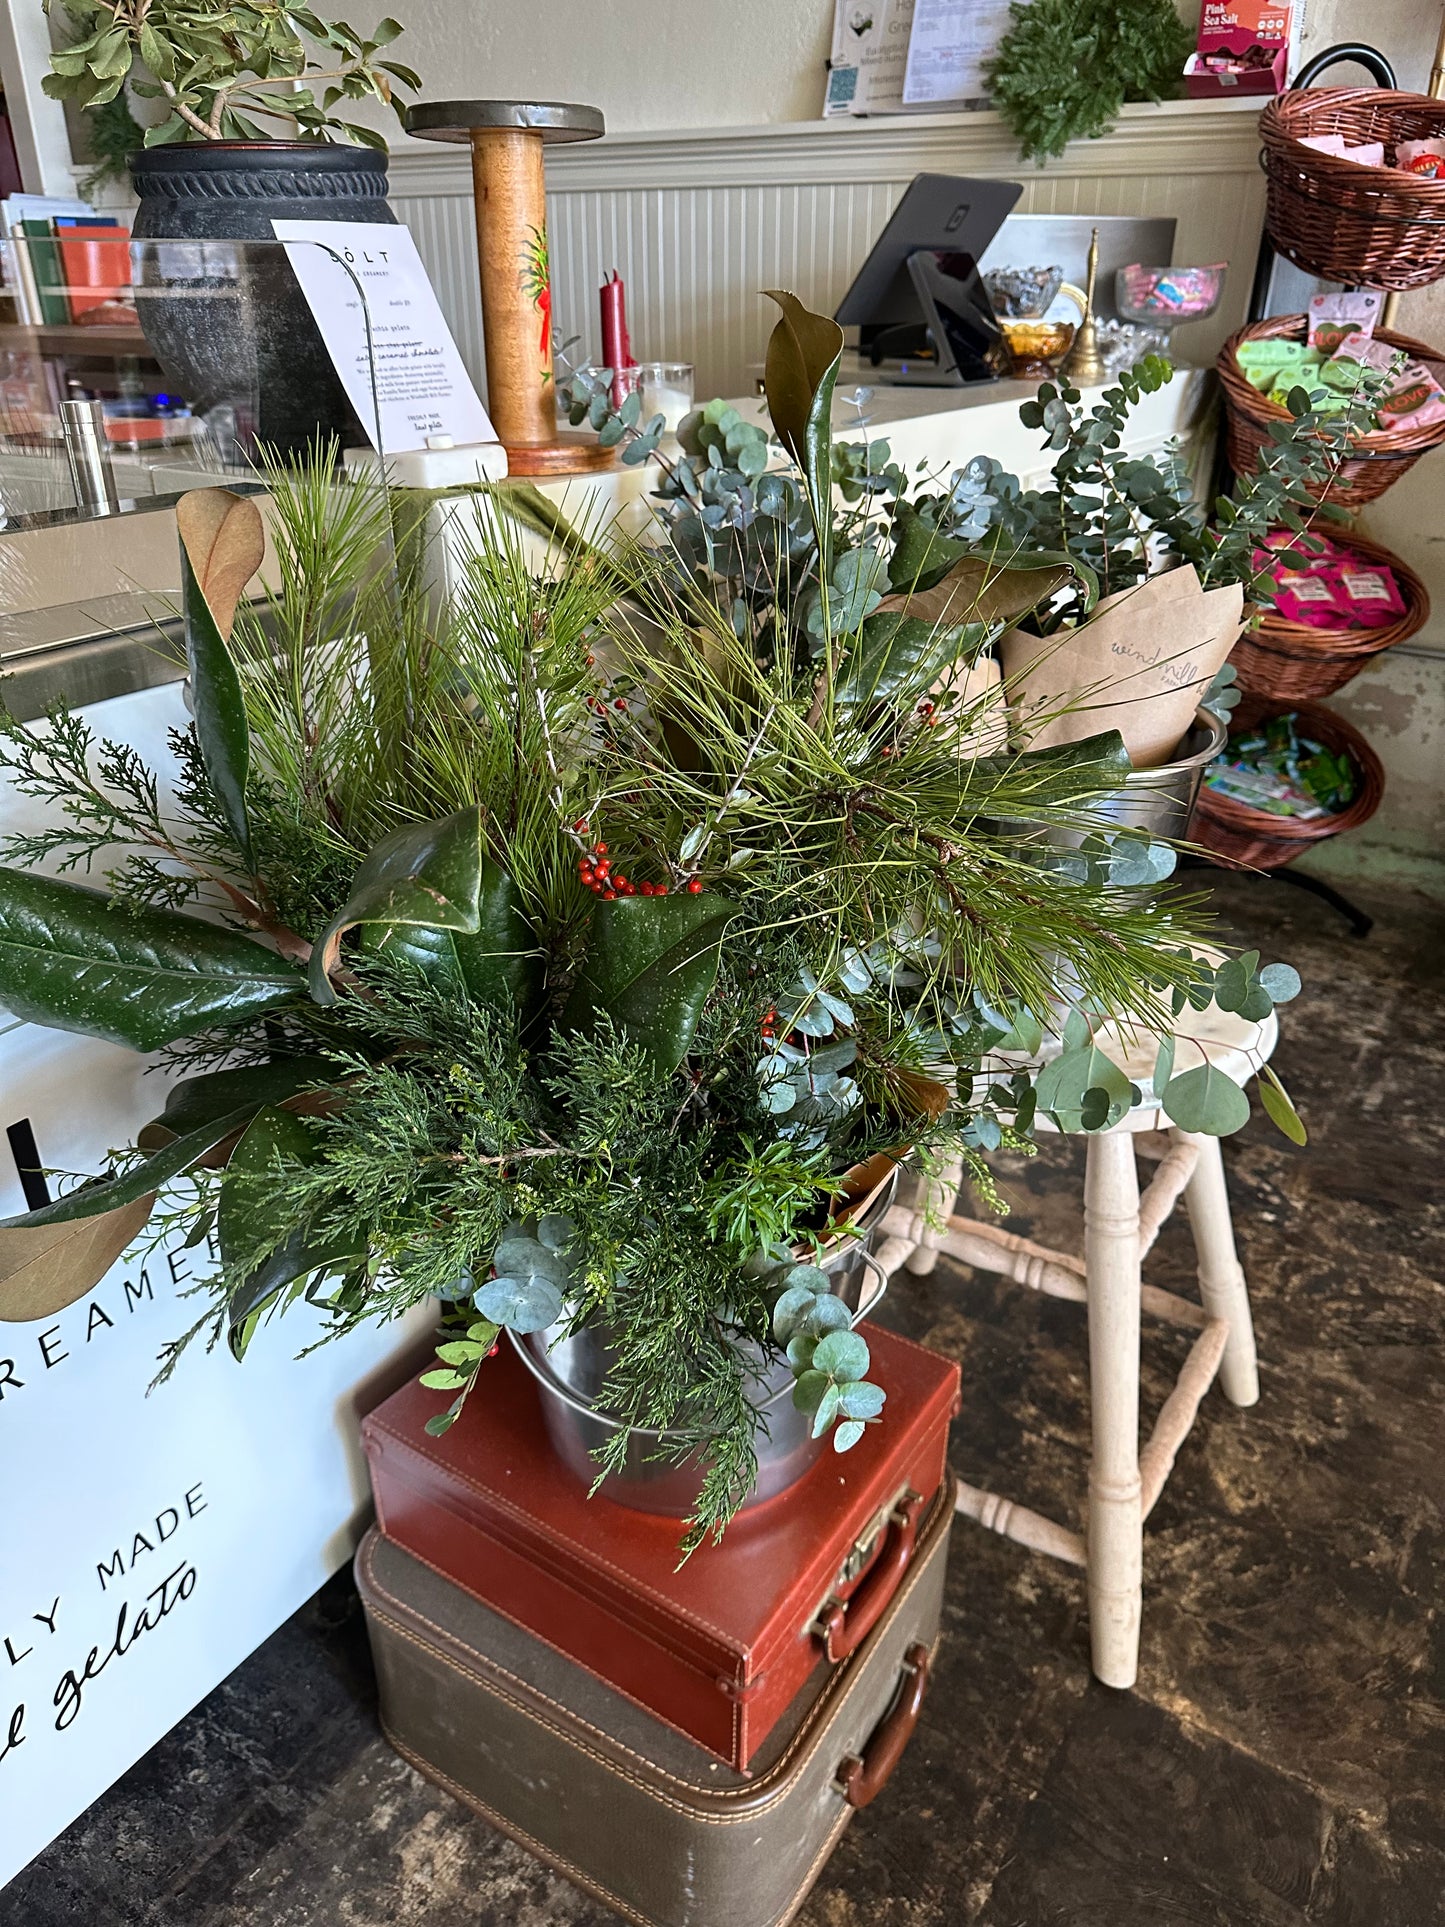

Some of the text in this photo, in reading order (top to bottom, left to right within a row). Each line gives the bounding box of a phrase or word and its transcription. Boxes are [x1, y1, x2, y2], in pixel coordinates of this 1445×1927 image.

[1204, 13, 1239, 27] Sea Salt
[1205, 3, 1226, 15] Pink
[96, 1481, 208, 1591] MADE
[53, 1560, 196, 1731] gelato
